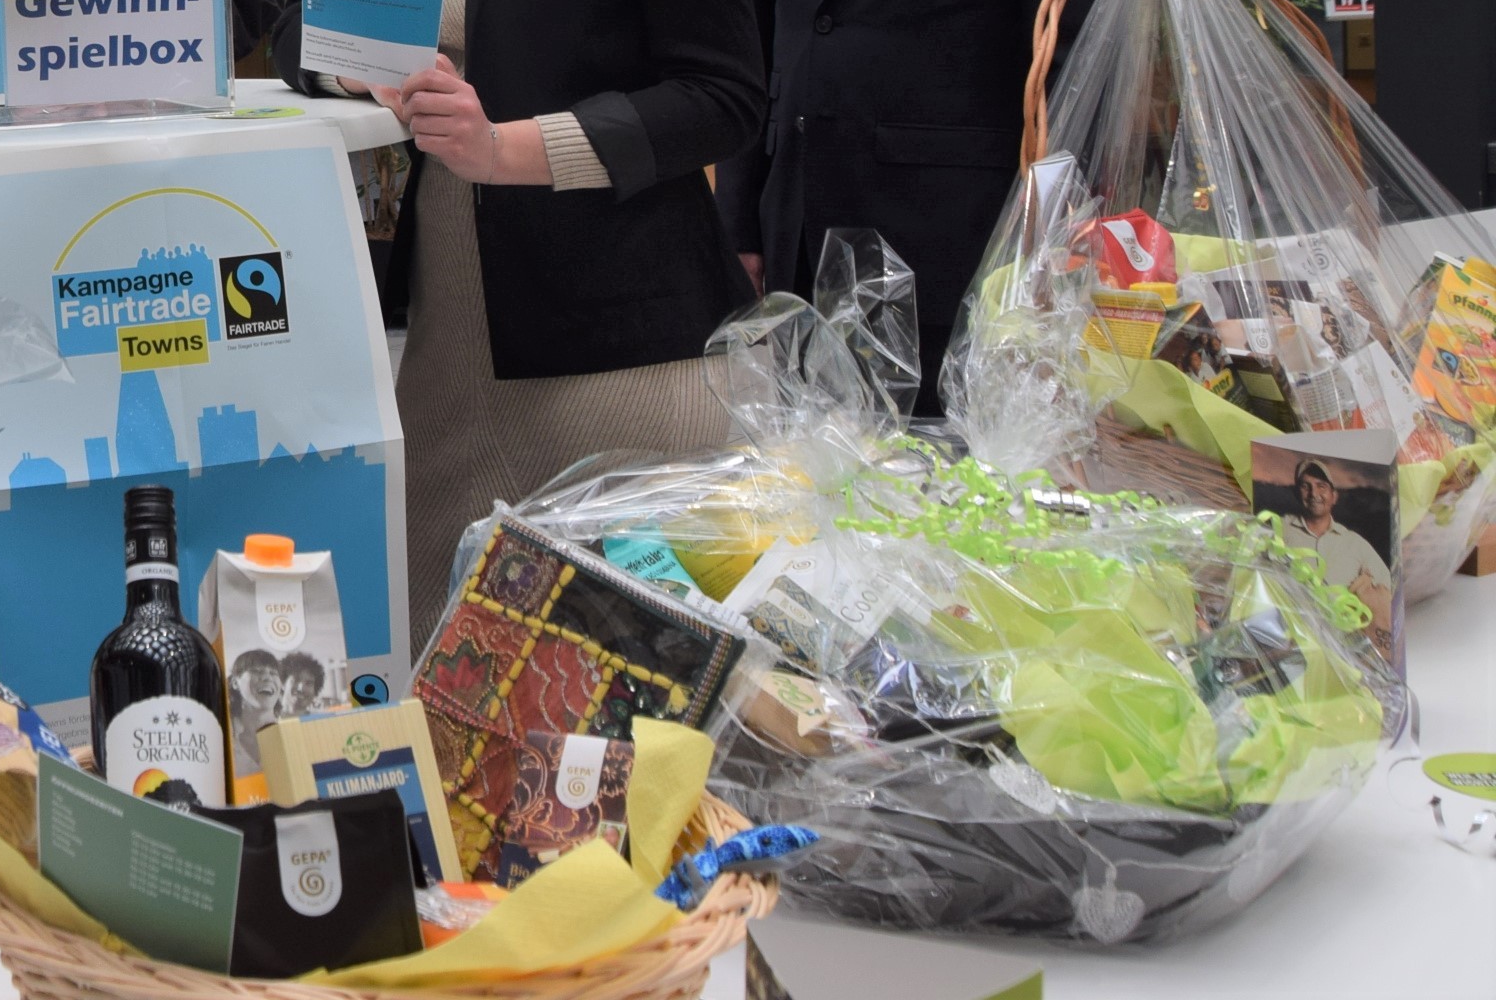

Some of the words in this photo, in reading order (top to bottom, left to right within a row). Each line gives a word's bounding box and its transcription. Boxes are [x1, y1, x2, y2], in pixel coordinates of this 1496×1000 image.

[16, 33, 204, 81] spielbox
[58, 269, 194, 299] Kampagne
[60, 289, 212, 330] Fairtrade
[229, 318, 287, 337] FAIRTRADE
[121, 333, 205, 358] Towns
[265, 603, 293, 613] GEPA
[133, 728, 209, 751] STELLAR
[136, 747, 210, 764] ORGANICS
[567, 766, 592, 777] GEPA
[290, 851, 328, 866] GEPA
[509, 863, 530, 878] Bio
